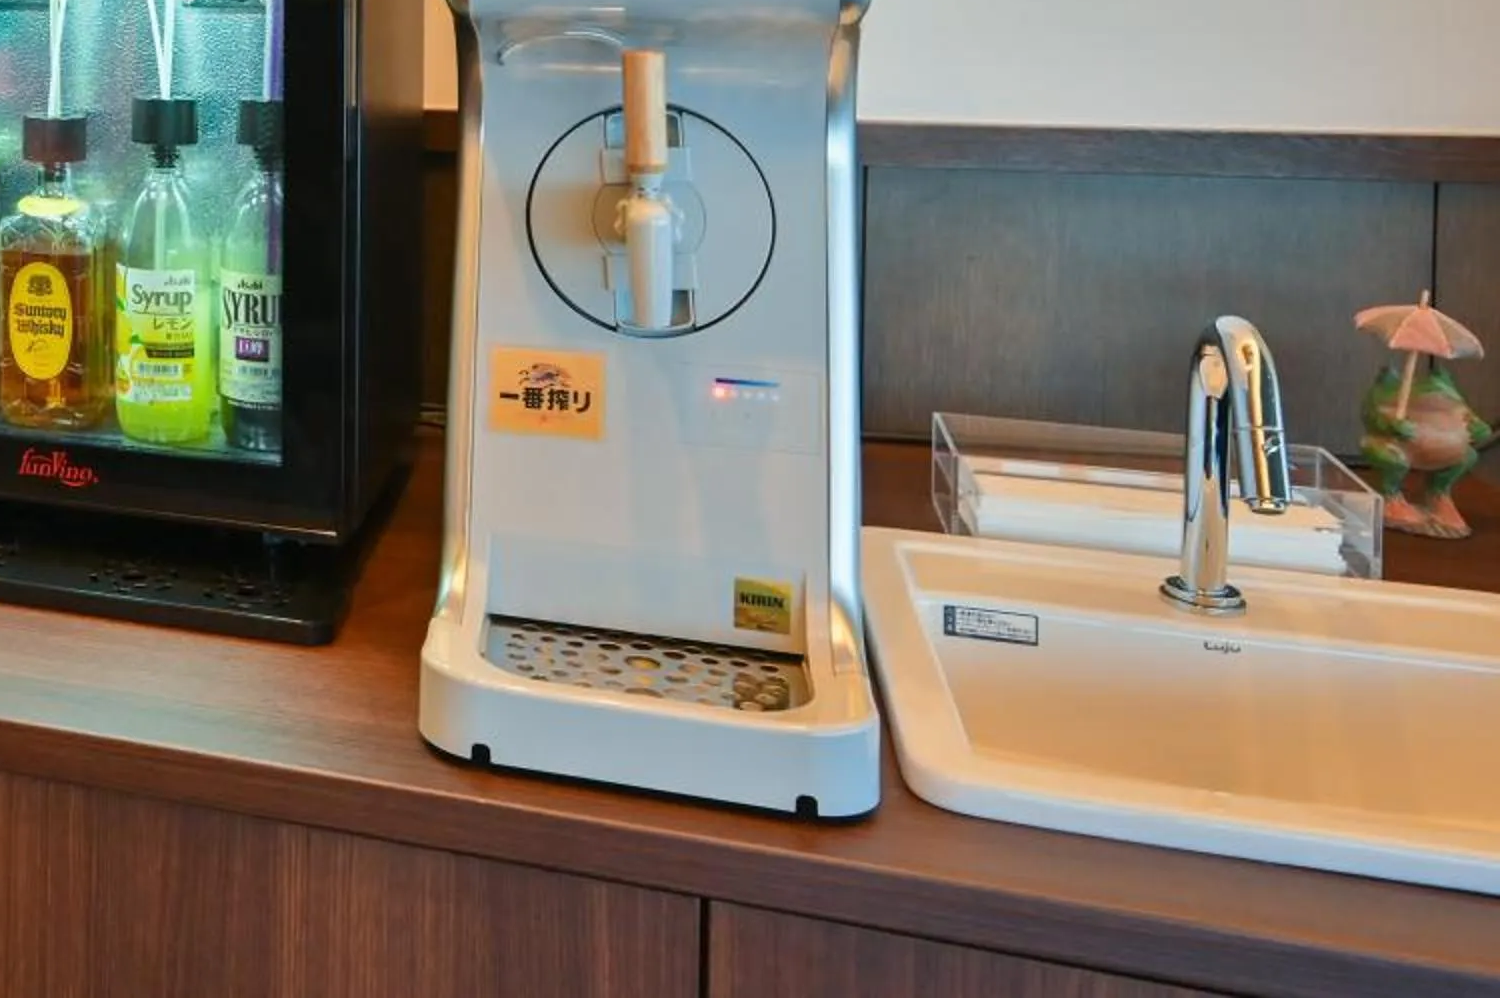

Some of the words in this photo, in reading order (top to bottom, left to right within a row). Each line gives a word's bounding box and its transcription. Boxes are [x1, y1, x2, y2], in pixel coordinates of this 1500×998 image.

[131, 283, 194, 313] Syrup
[14, 302, 67, 321] Suntory
[153, 316, 193, 331] レモン
[499, 387, 592, 414] 一番搾り
[739, 591, 785, 609] KIRIN
